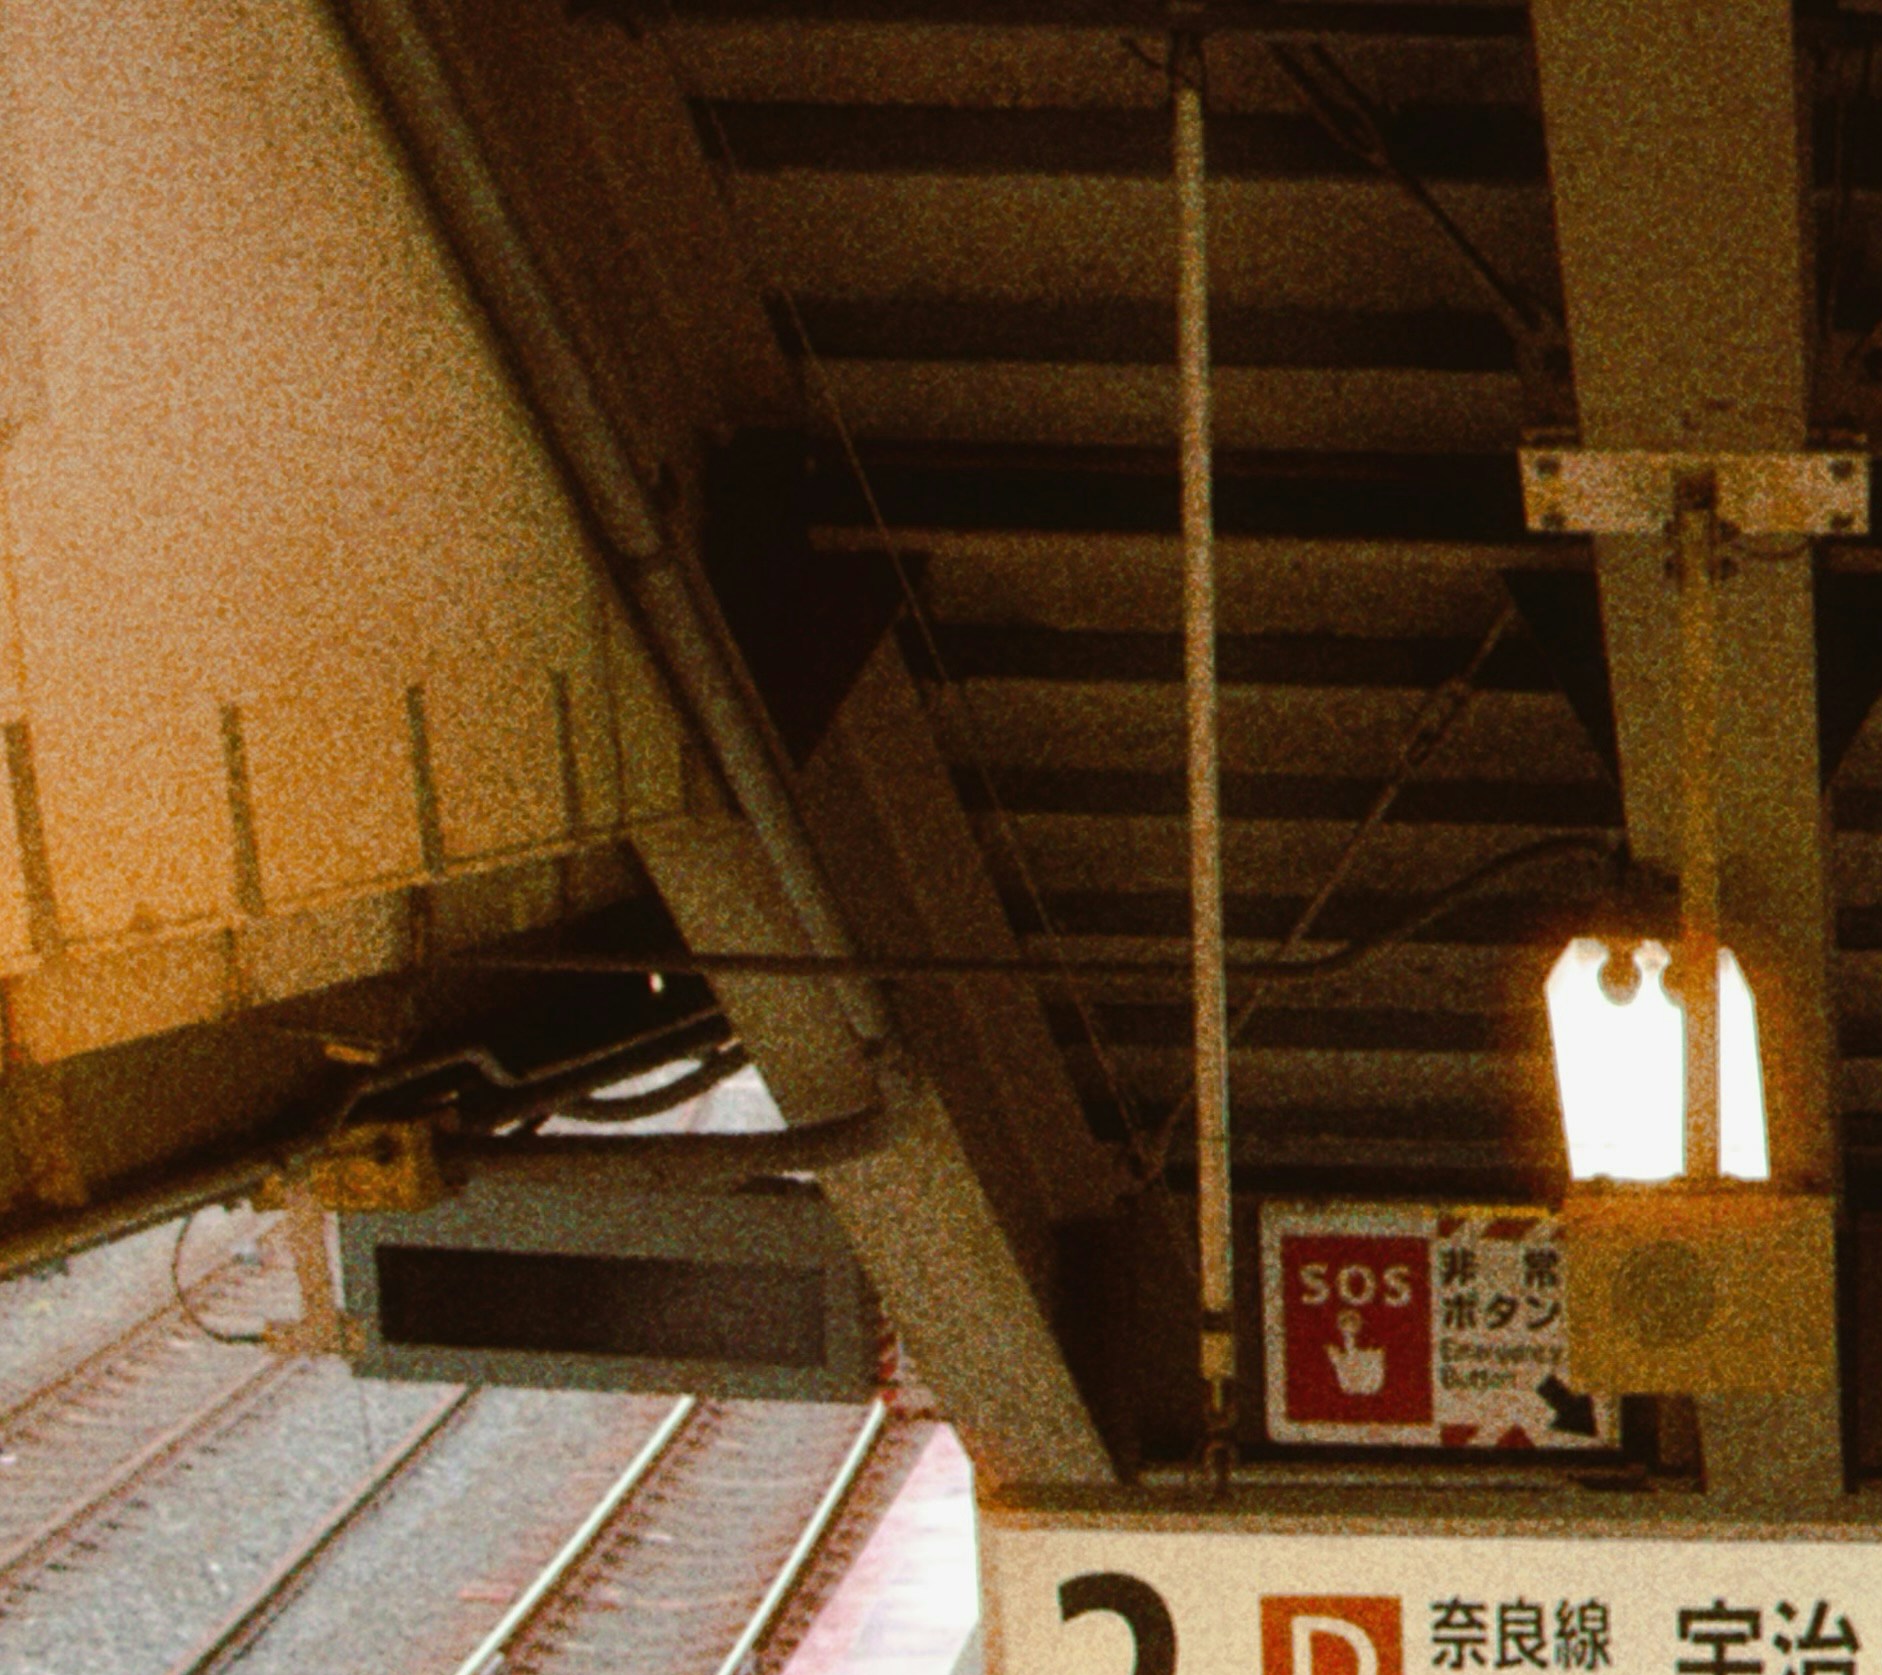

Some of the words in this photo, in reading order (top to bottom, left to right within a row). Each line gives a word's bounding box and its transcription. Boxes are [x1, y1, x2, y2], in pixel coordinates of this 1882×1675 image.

[1300, 1262, 1413, 1308] SOS
[1442, 1295, 1562, 1331] ボタン
[1430, 1597, 1611, 1671] 奈良線
